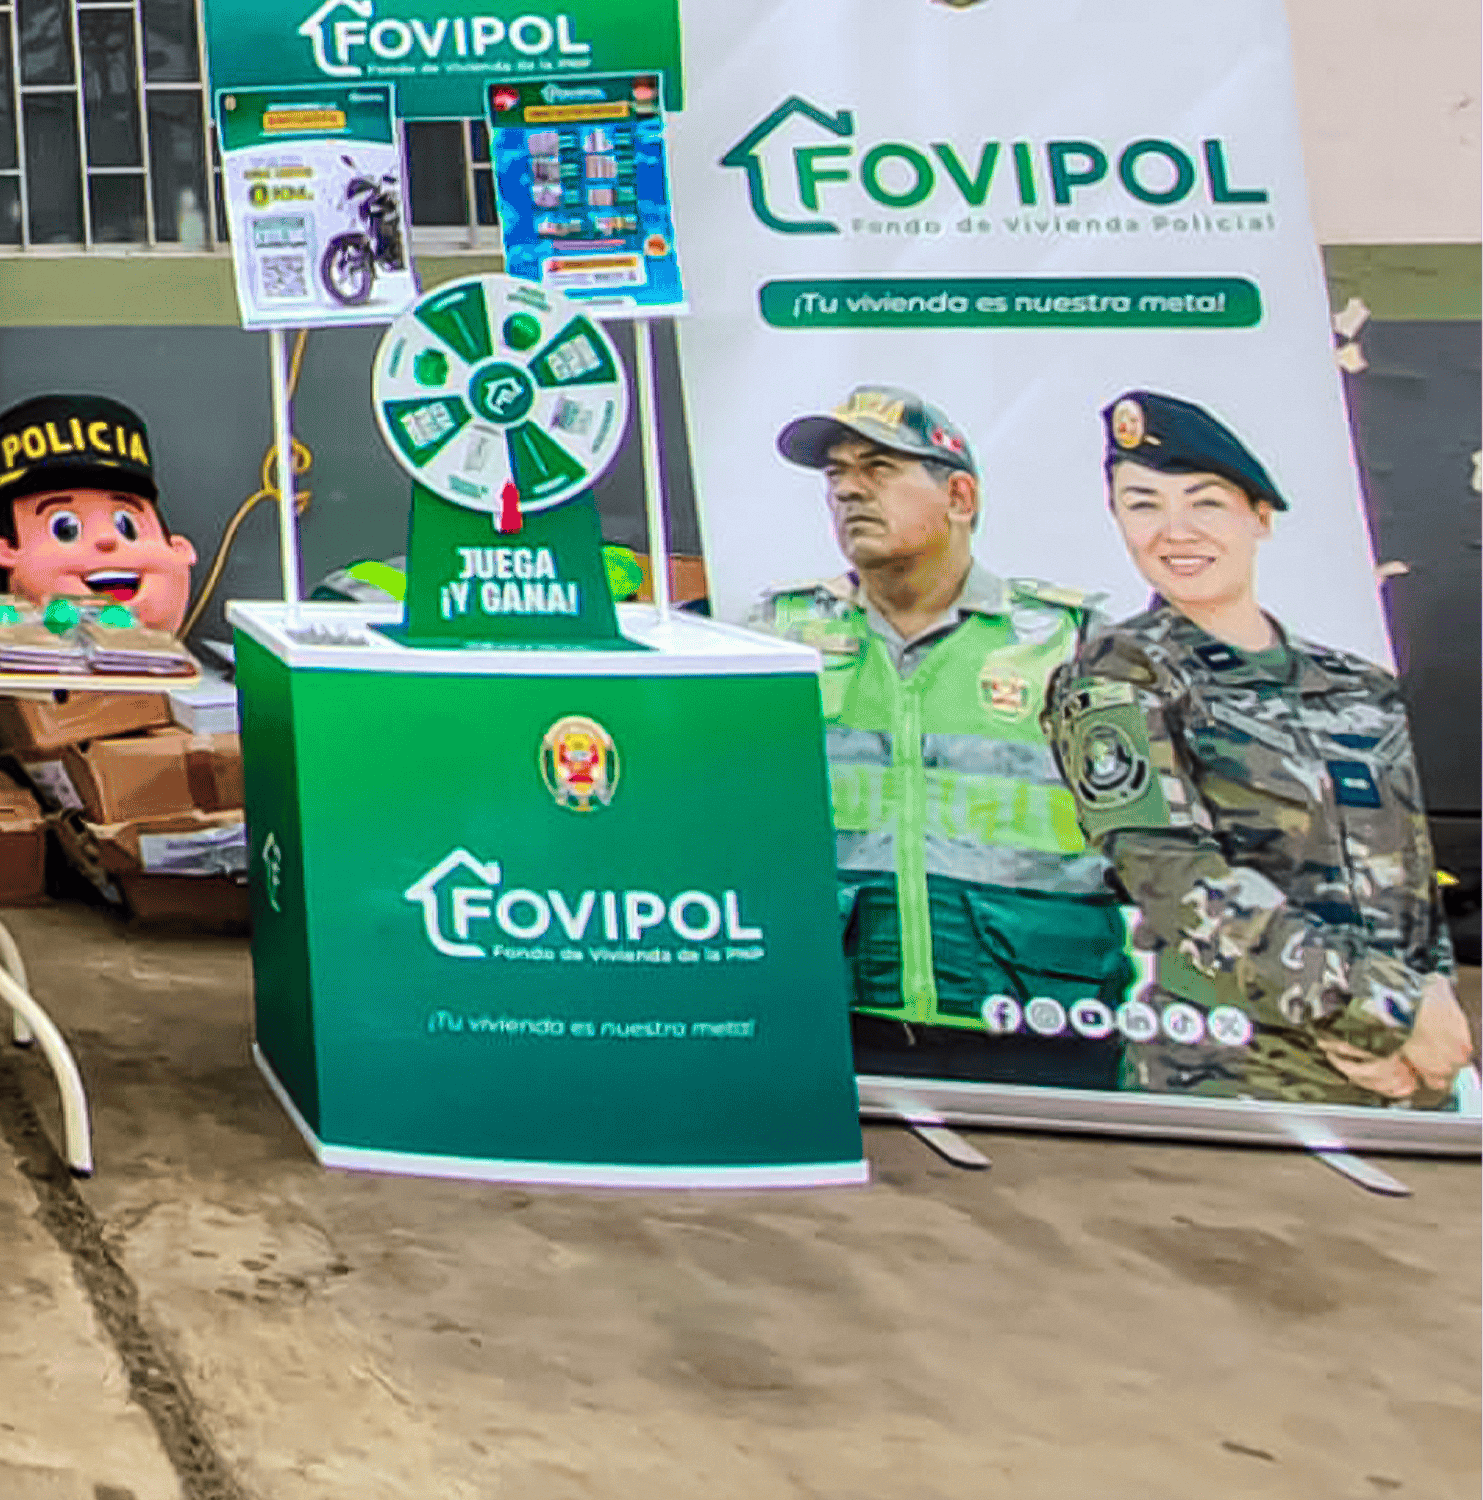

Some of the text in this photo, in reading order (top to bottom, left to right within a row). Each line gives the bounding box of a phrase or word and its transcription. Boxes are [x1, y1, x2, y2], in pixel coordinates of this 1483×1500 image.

[333, 13, 591, 62] FOVIPOL
[792, 140, 1268, 210] FOVIPOL
[852, 214, 1276, 235] Fondo de Vivienda Policial
[847, 292, 968, 313] vivienda
[975, 298, 1008, 313] es
[1015, 295, 1130, 313] nuestra
[1, 418, 149, 468] POLICIA
[456, 548, 555, 578] JUEGA
[442, 582, 578, 619] ¡Y GANA!
[451, 889, 762, 941] FOVIPOL
[494, 945, 555, 960] Fondo
[560, 948, 583, 961] de
[590, 947, 671, 962] Vivienda
[677, 949, 700, 961] de
[703, 947, 721, 961] la
[469, 1017, 564, 1036] vivienda
[570, 1022, 595, 1036] es
[601, 1020, 684, 1037] nuestra
